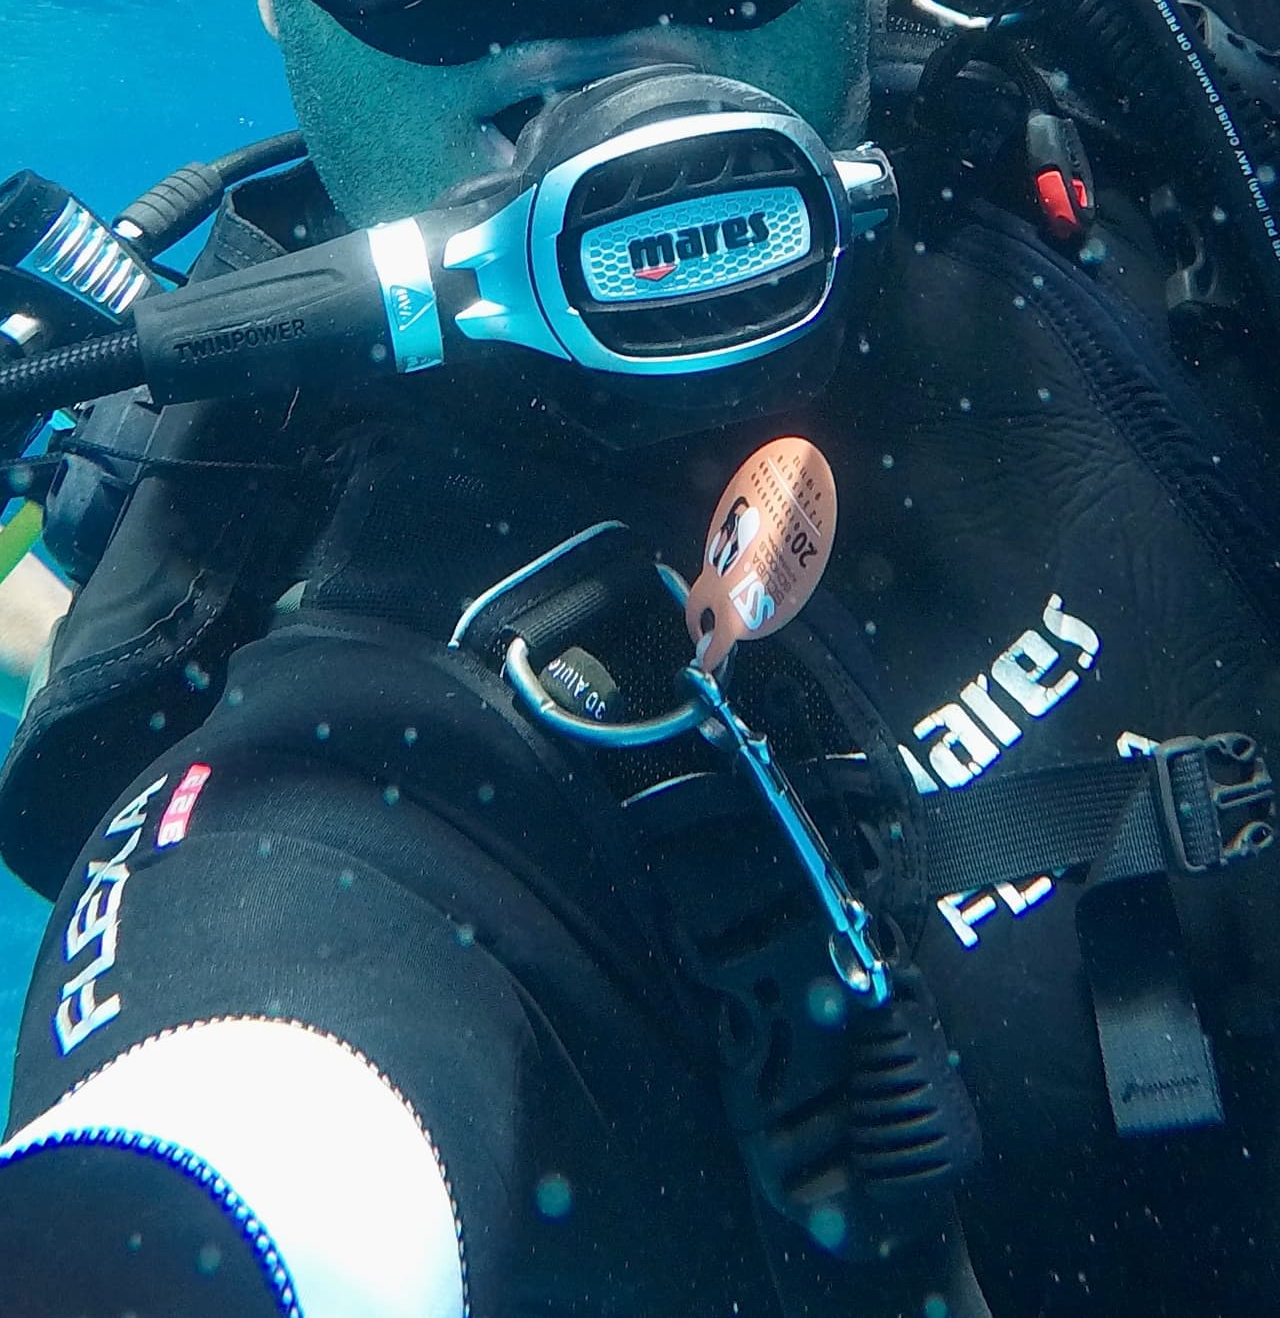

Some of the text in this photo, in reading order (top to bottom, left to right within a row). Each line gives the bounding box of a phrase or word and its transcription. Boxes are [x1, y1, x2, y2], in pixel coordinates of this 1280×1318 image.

[1176, 33, 1192, 51] OR
[1187, 52, 1220, 103] DAMAGE
[1214, 104, 1241, 147] CAUSE
[1234, 150, 1254, 176] MAY
[628, 210, 770, 268] mares
[173, 318, 307, 363] TWINPOWER
[54, 773, 169, 1056] FLEXA
